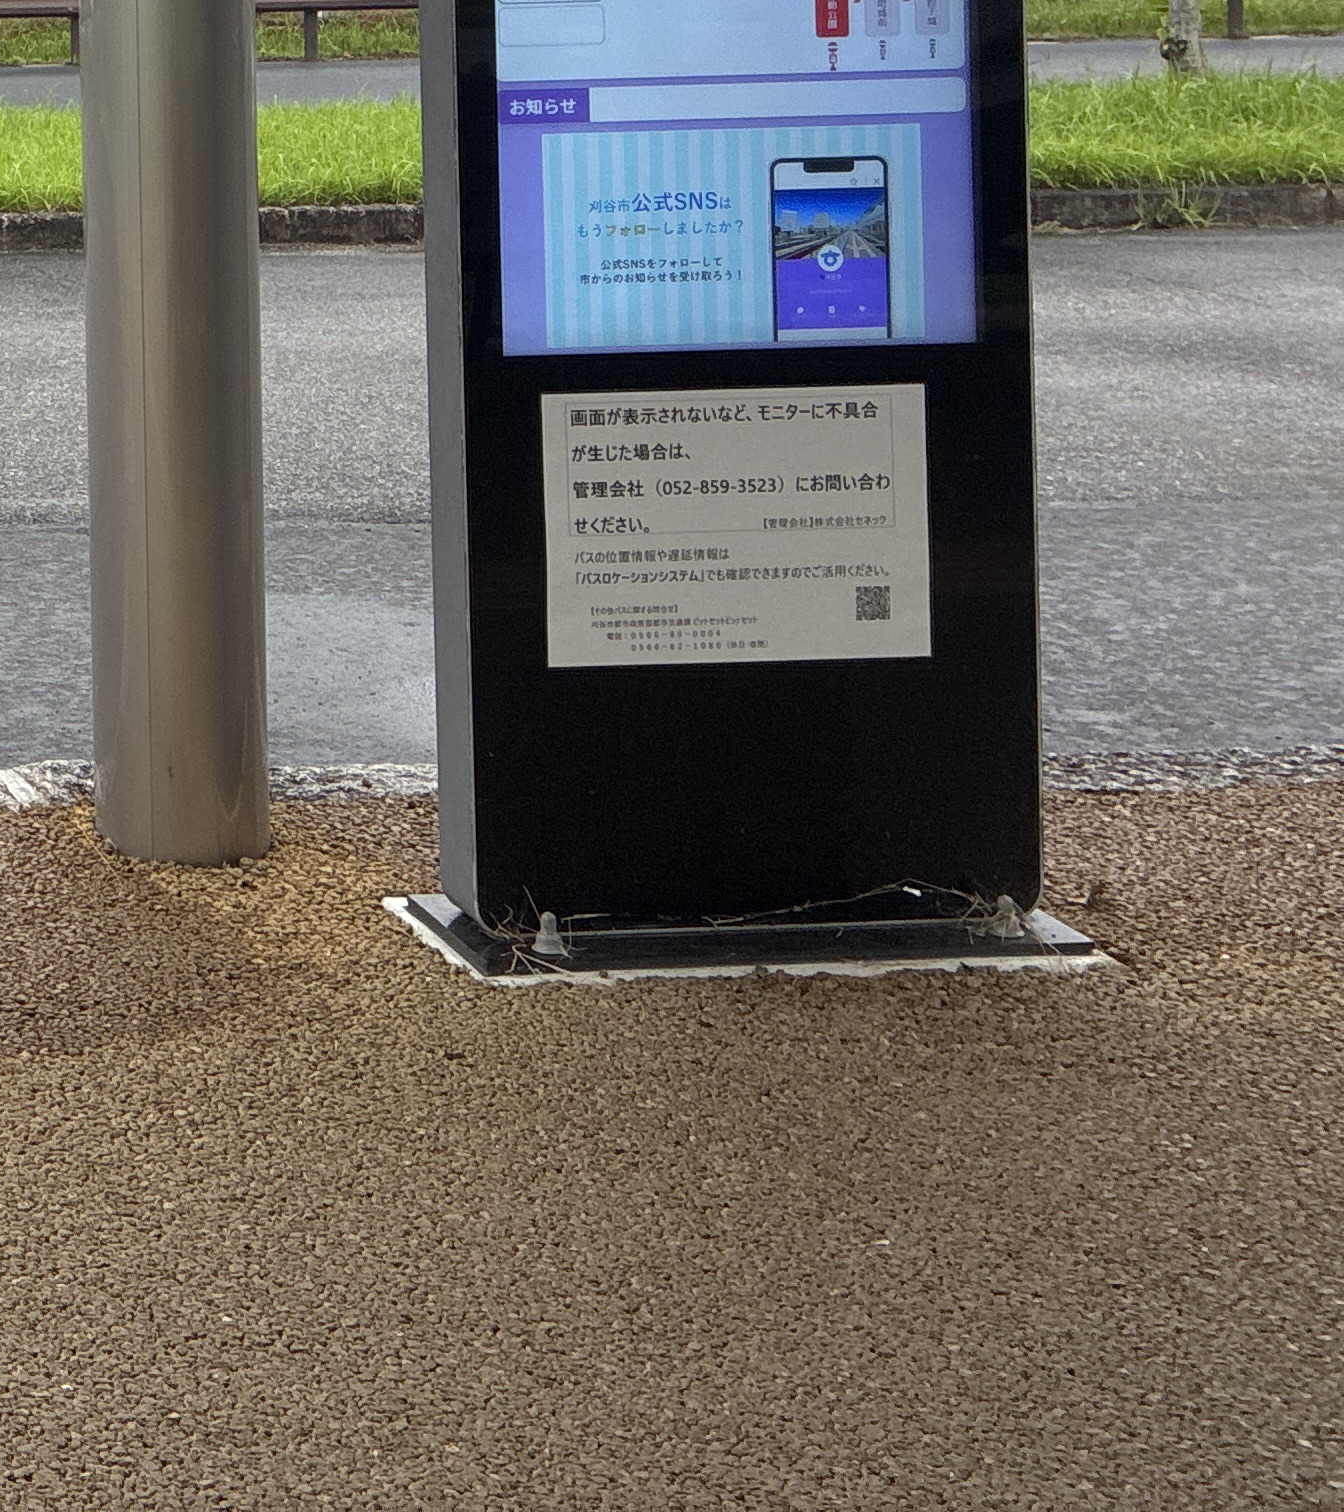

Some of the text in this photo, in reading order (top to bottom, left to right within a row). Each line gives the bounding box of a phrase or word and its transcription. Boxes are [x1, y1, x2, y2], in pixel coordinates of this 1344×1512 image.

[509, 98, 576, 116] お知らせ
[588, 191, 732, 214] 刈谷市公式SNSは
[601, 257, 723, 271] 公式SNSをフォローして
[579, 270, 742, 285] 市からのお知らせを受け取ろう！
[570, 401, 878, 427] 画面が表示されないなど、モニターに不具合
[571, 443, 692, 463] が生じた場合は、
[574, 516, 651, 534] せください。
[574, 548, 730, 564] バスの位置情報や遅延情報は
